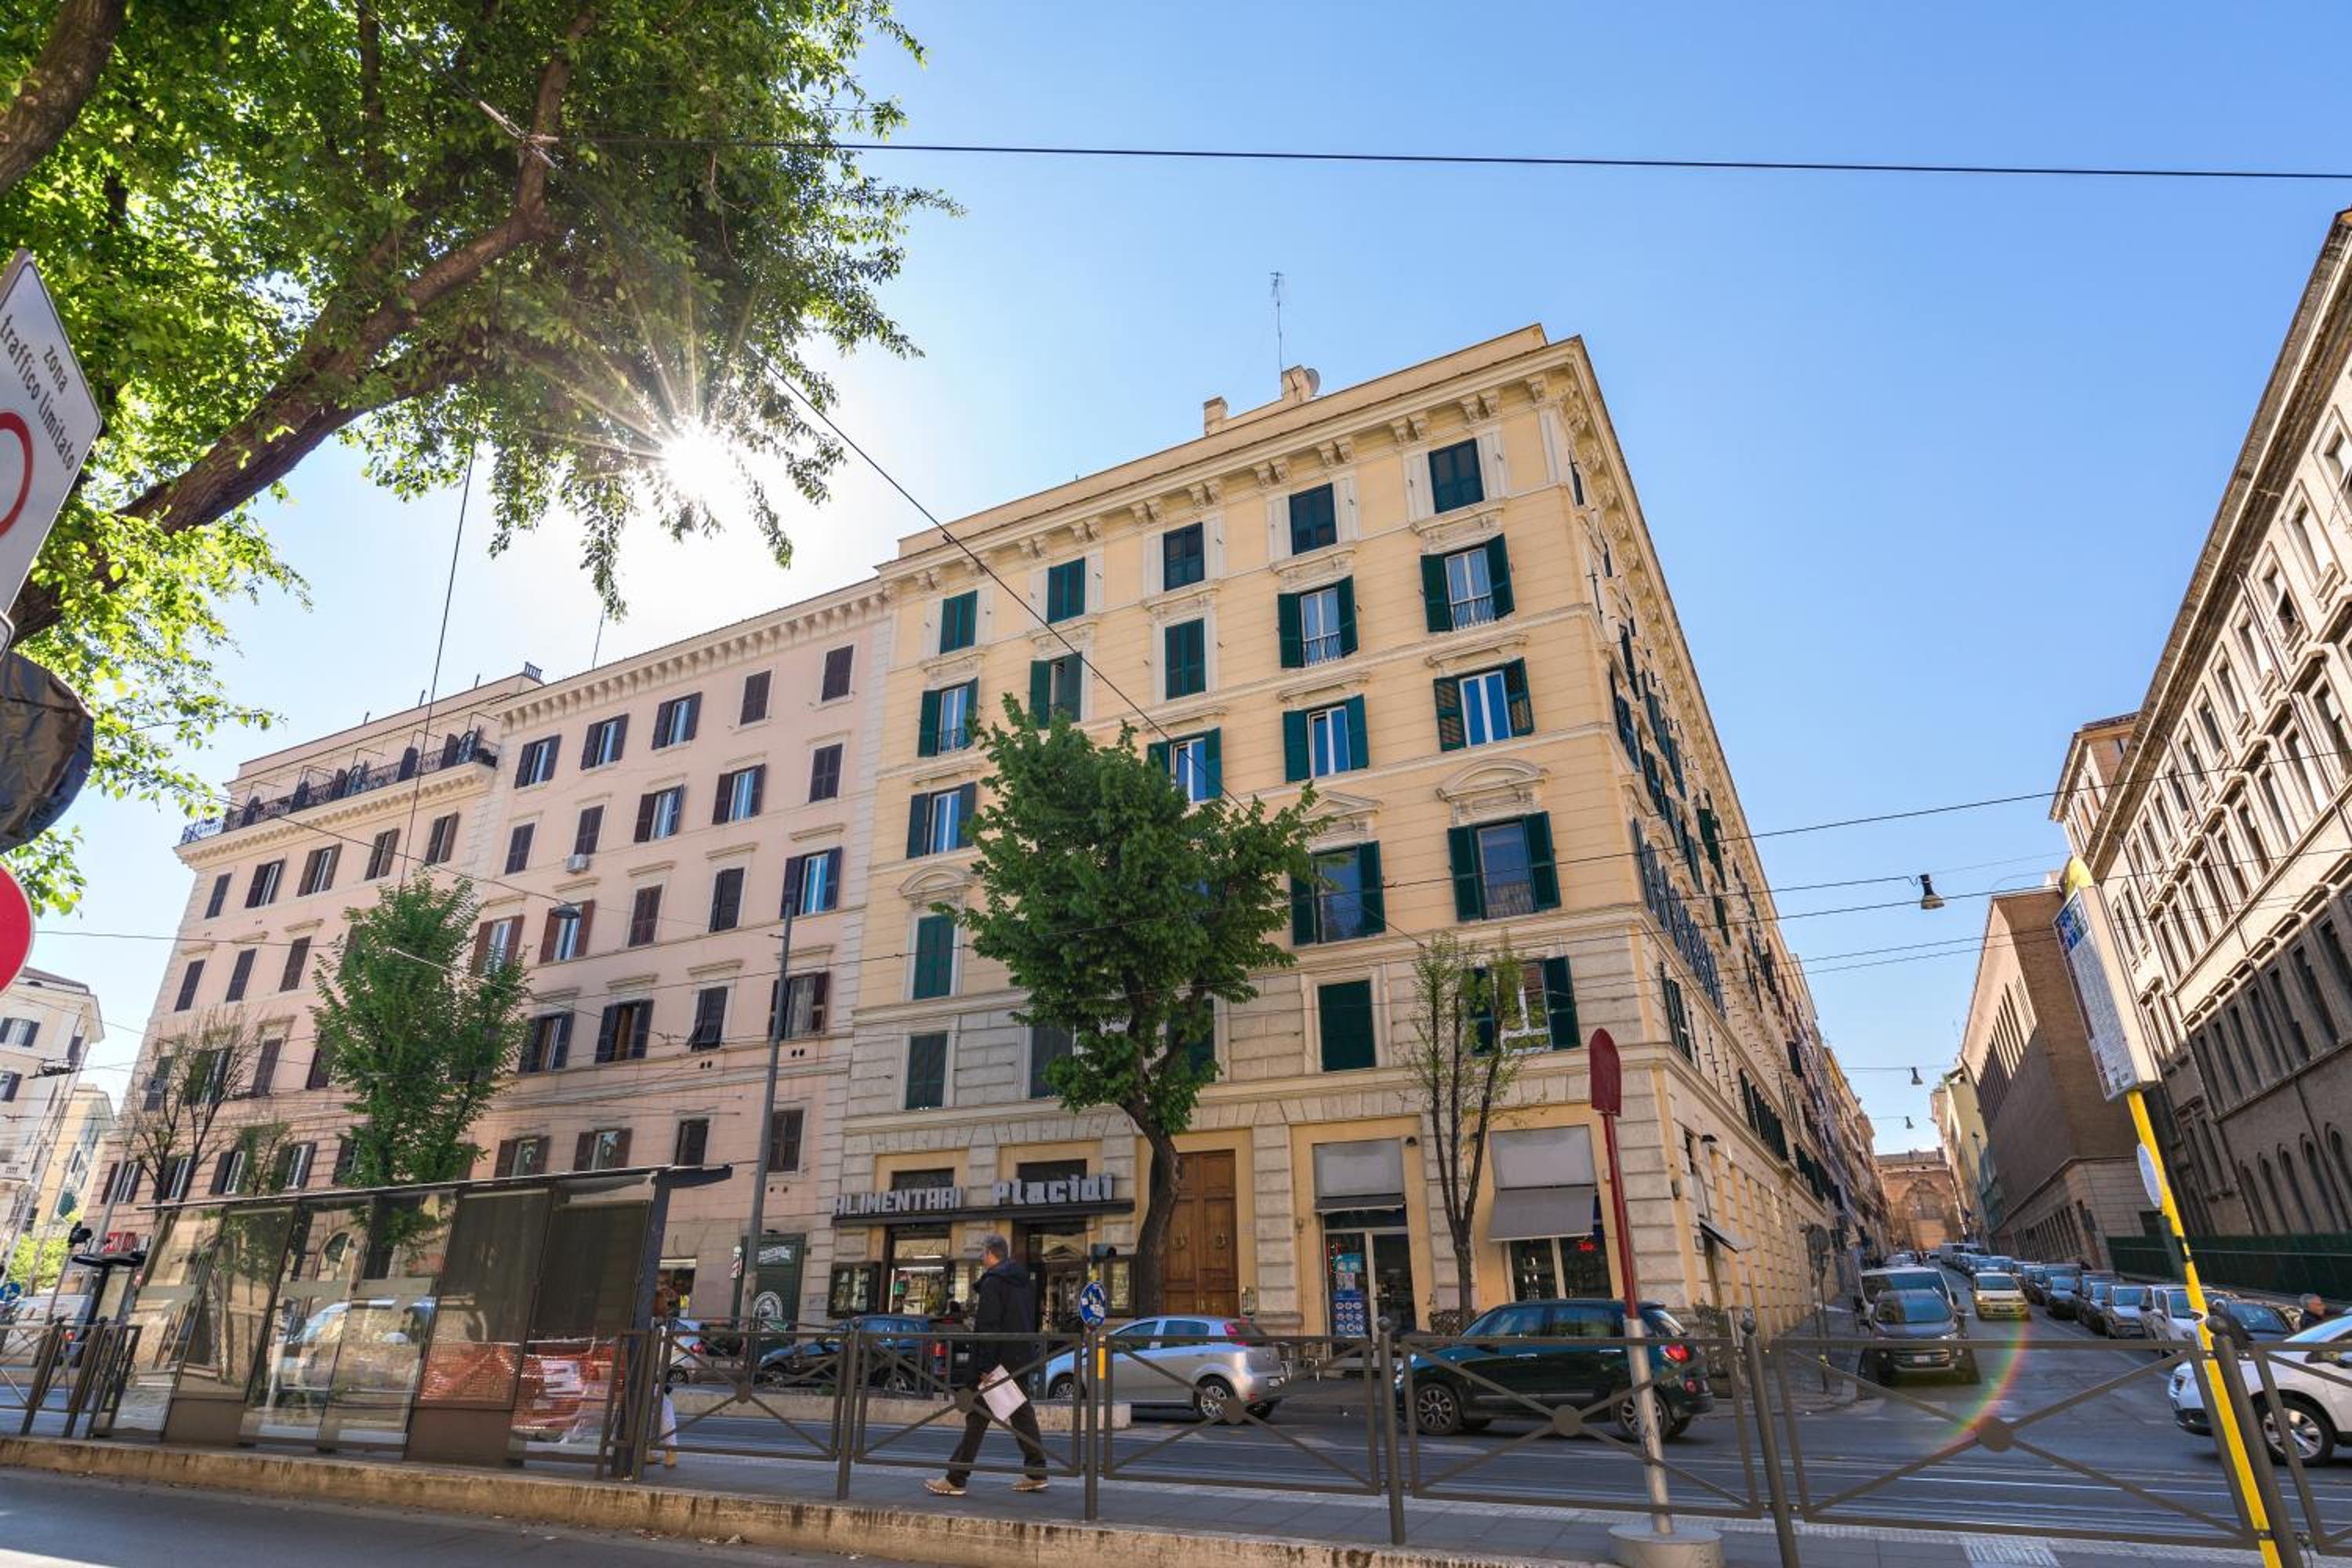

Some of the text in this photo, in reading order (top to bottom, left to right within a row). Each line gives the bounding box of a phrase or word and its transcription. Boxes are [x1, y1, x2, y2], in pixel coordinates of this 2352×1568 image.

[0, 314, 75, 470] traffico limitato
[43, 345, 67, 394] zona
[833, 1187, 965, 1216] ALIMENTARI
